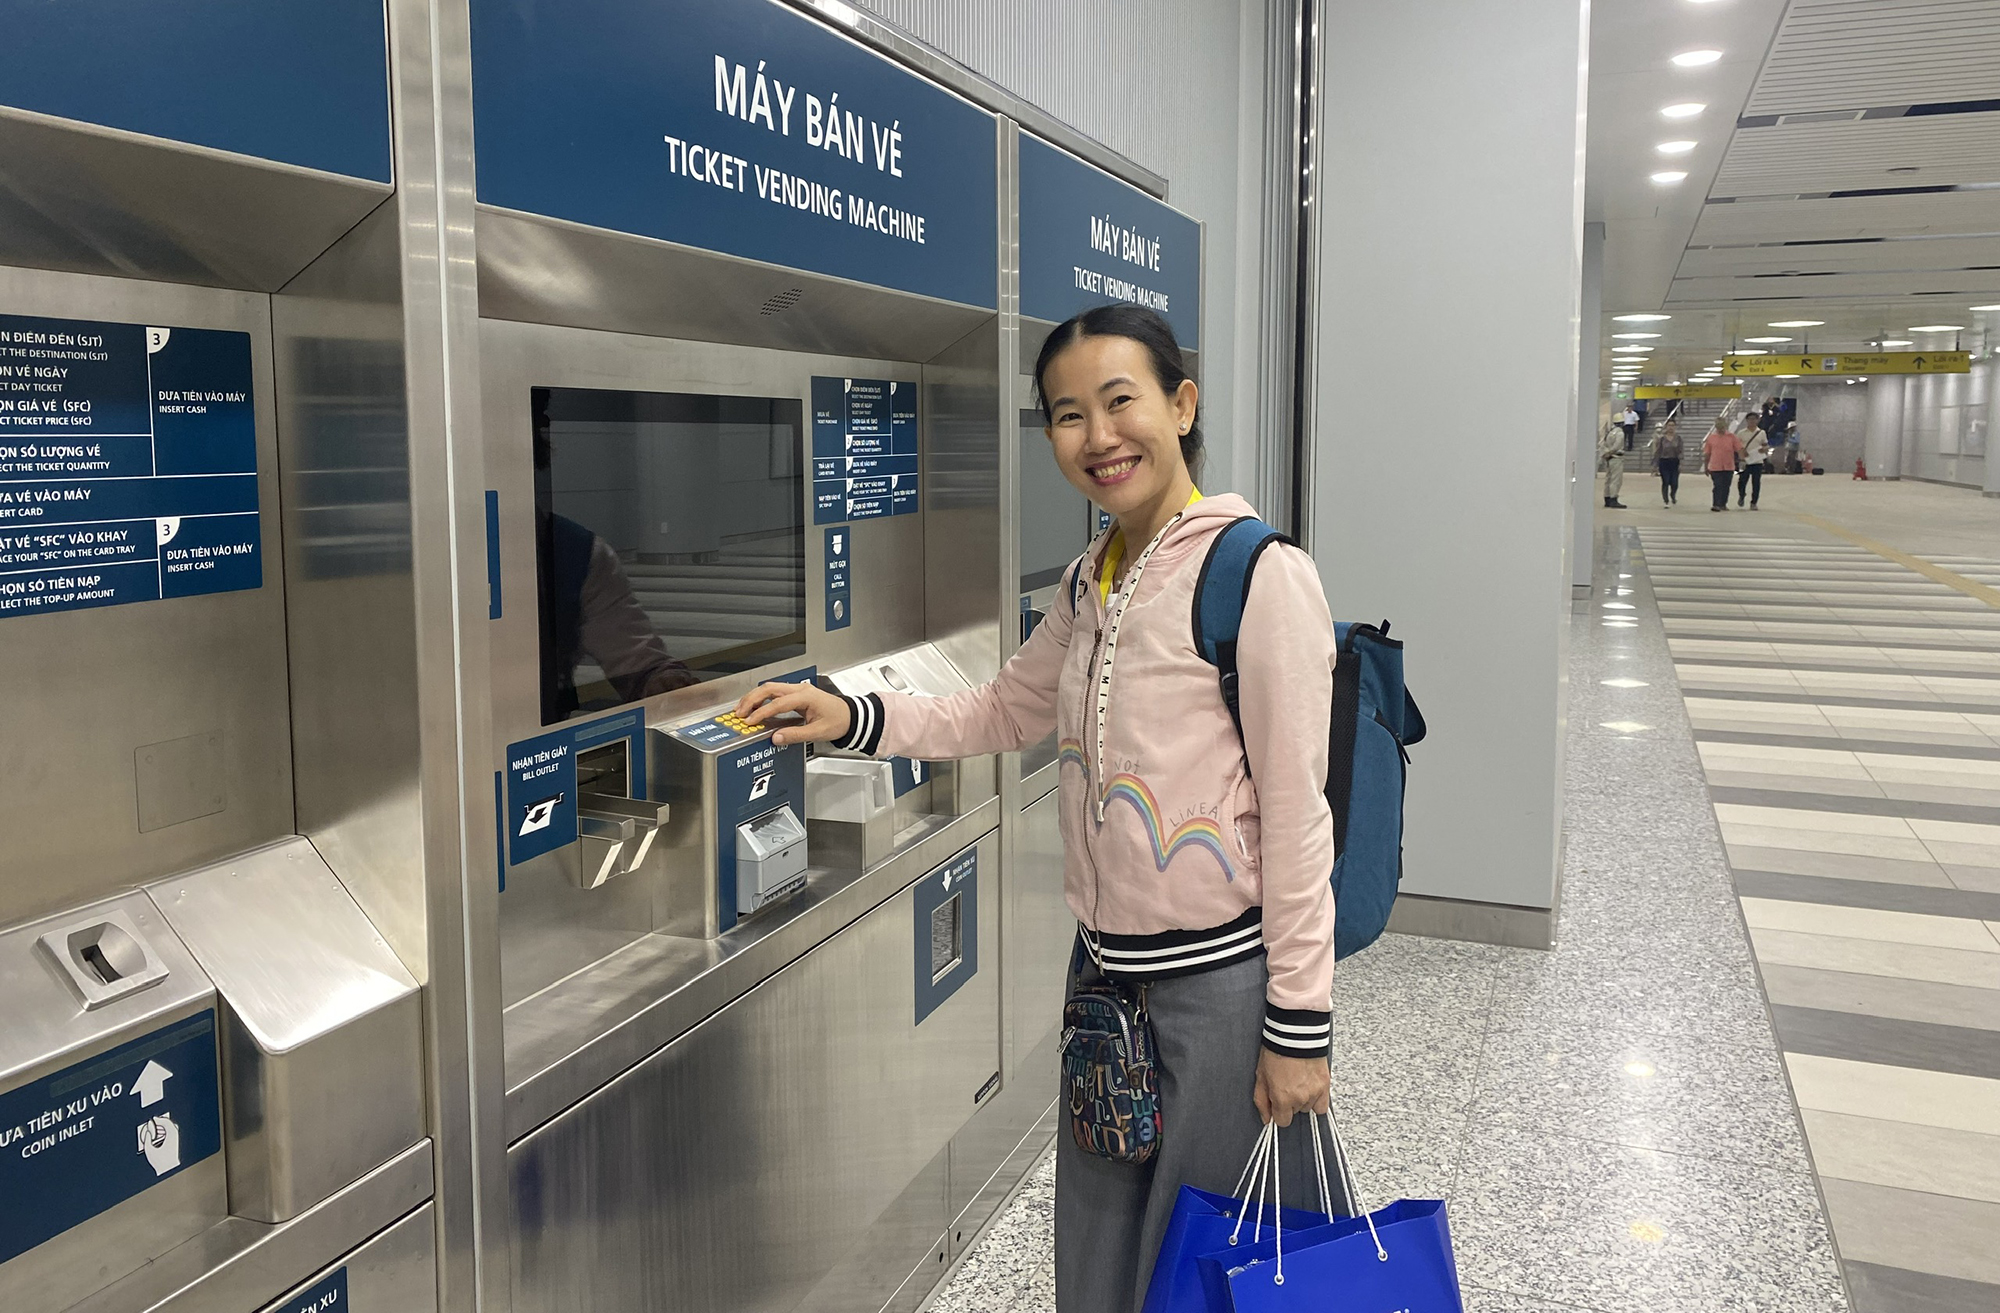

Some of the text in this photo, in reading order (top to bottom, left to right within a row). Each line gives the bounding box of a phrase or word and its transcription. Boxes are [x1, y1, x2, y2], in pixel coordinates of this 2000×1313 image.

[715, 54, 903, 178] MÁY BÁN VÉ
[664, 135, 926, 244] TICKET VENDING MACHINE
[1091, 214, 1161, 272] MÁY BÁN VÉ
[1073, 266, 1169, 312] TICKET VENDING MACHINE
[77, 334, 103, 348] (SJT)
[153, 333, 161, 346] 3
[0, 347, 108, 361] T THE DESTINATION (SJT)
[15, 364, 31, 377] VÉ
[34, 365, 68, 378] NGÀY
[11, 382, 31, 392] DAY
[33, 383, 63, 393] TICKET
[158, 390, 181, 401] ĐƯA
[204, 390, 224, 402] VÀO
[226, 391, 246, 403] MÁY
[17, 398, 39, 412] GIÁ
[41, 398, 57, 412] VÉ
[63, 399, 91, 413] (SFC)
[159, 405, 207, 415] INSERT CASH
[12, 416, 43, 426] TICKET
[45, 416, 69, 426] PRICE
[70, 416, 92, 427] (SFC)
[40, 445, 83, 460] LƯỢNG
[85, 444, 101, 457] VÉ
[15, 463, 33, 472] THE
[35, 462, 65, 472] TICKET
[66, 461, 111, 471] QUANTITY
[15, 489, 31, 503] VÉ
[34, 489, 62, 502] VÀO
[64, 488, 92, 501] MÁY
[18, 507, 43, 517] CARD
[163, 523, 171, 536] 3
[15, 534, 31, 549] VÉ
[68, 531, 94, 545] VÀO
[97, 529, 128, 543] KHAY
[15, 552, 39, 562] YOUR
[64, 549, 76, 558] ON
[77, 548, 92, 558] THE
[94, 546, 115, 556] CARD
[116, 545, 136, 554] TRAY
[167, 550, 189, 561] ĐƯA
[211, 545, 232, 558] VÀO
[233, 543, 253, 556] MÁY
[167, 561, 215, 573] INSERT CASH
[77, 574, 102, 590] NẠP
[24, 596, 41, 607] THE
[43, 593, 75, 604] TOP-UP
[76, 588, 115, 602] AMOUNT
[512, 754, 533, 771] NHẬN
[753, 760, 774, 774] BILL INLET
[522, 762, 560, 782] BILL OUTLET
[66, 1097, 87, 1119] XU
[90, 1082, 122, 1106] VÀO
[21, 1116, 95, 1158] COIN INLET
[320, 1288, 338, 1310] XU
